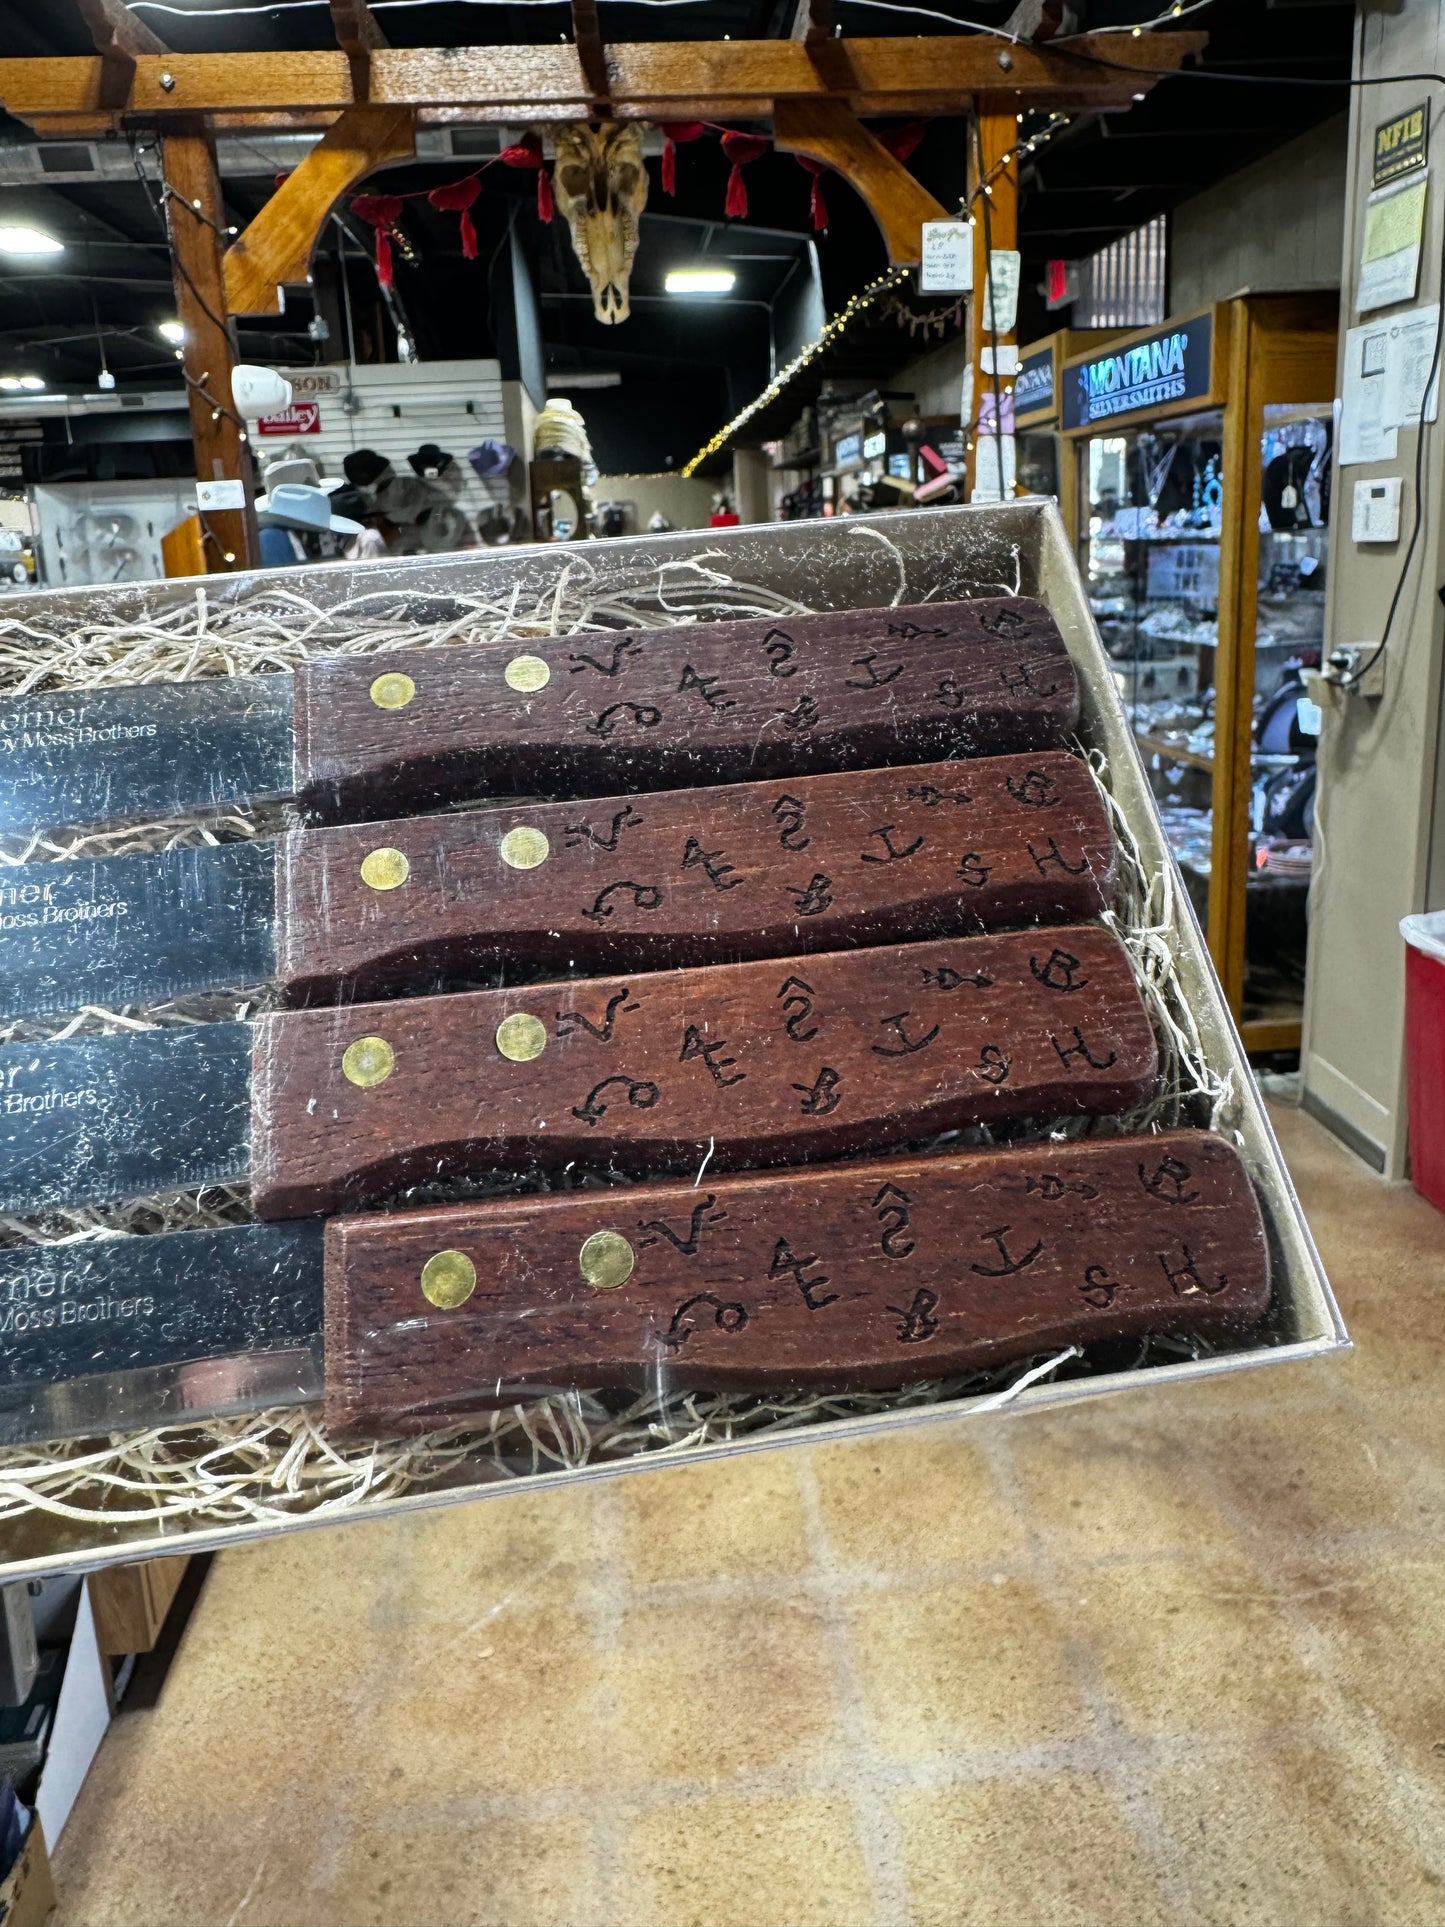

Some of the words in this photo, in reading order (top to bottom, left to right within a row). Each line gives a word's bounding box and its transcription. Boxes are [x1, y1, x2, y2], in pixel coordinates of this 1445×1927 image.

[1089, 334, 1185, 398] MONTANA
[23, 731, 74, 748] Moss
[79, 723, 157, 743] Brothers
[0, 913, 39, 930] oss
[43, 901, 128, 924] Brothers
[6, 1088, 97, 1113] Brothers
[61, 1295, 154, 1324] Brothers
